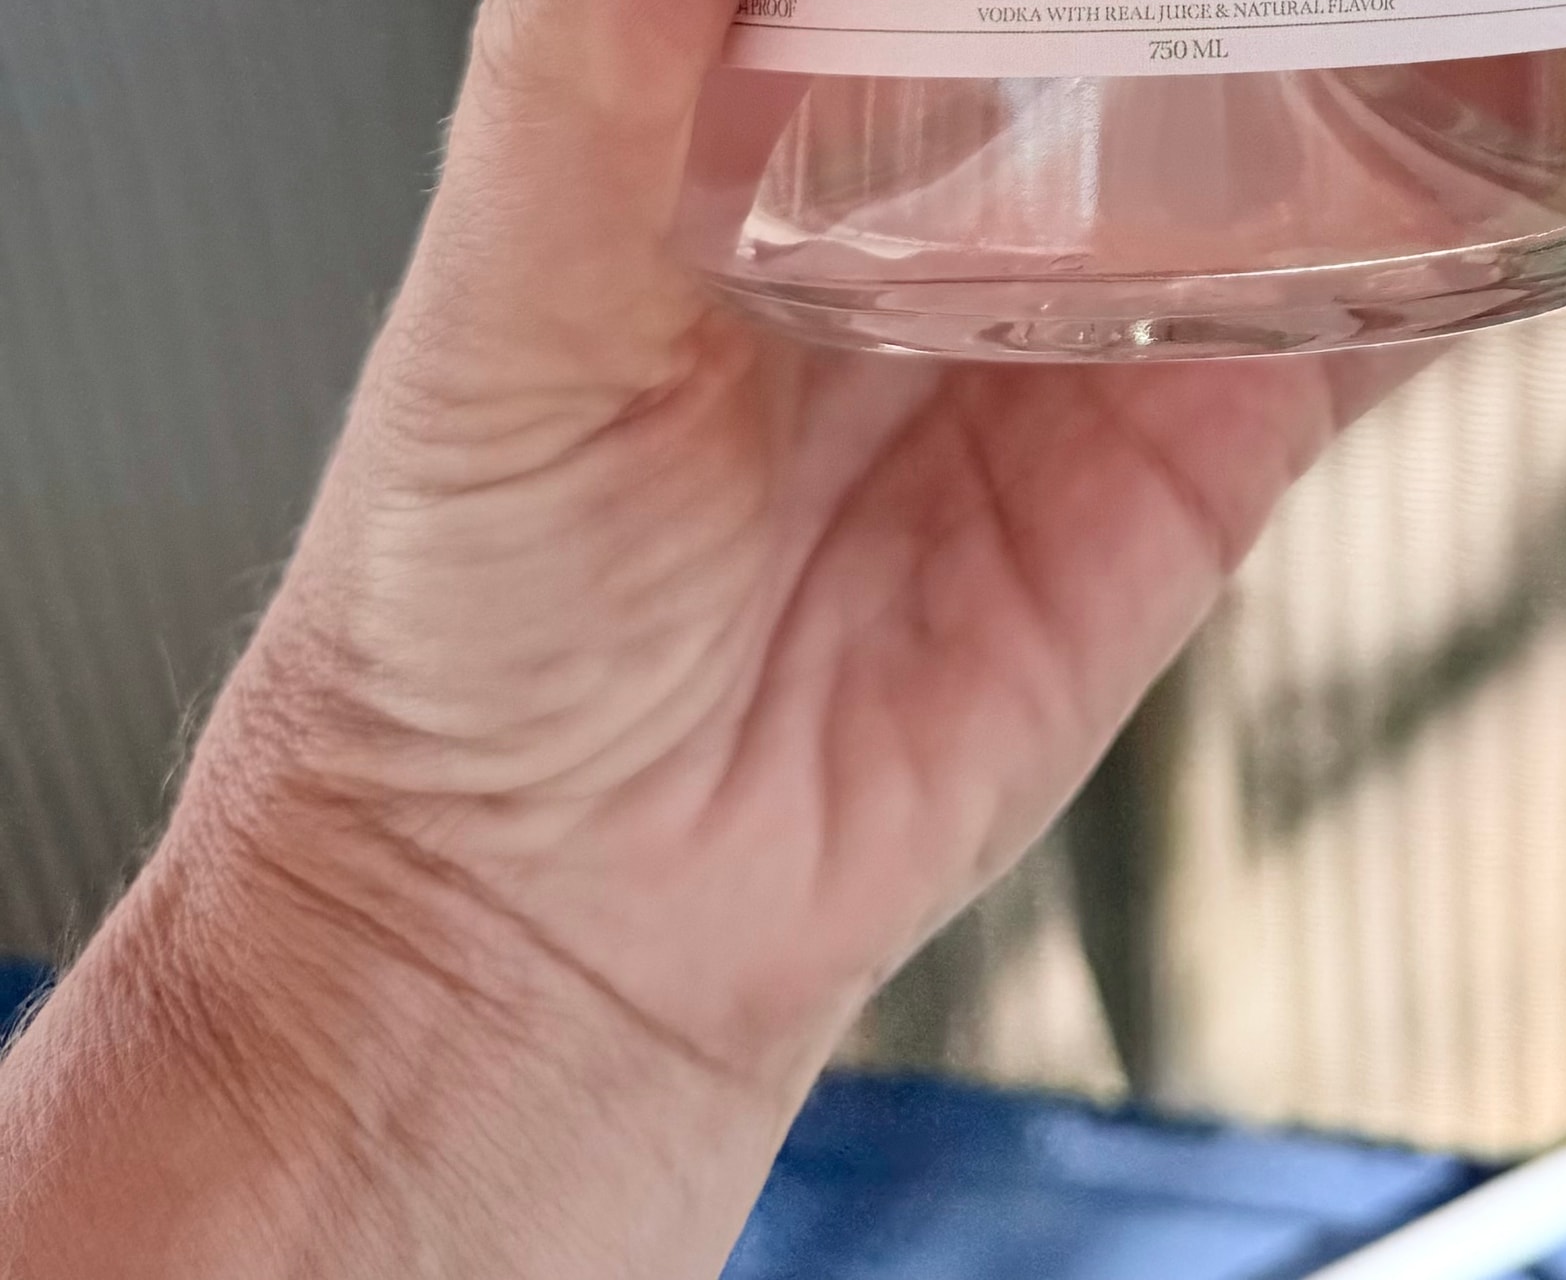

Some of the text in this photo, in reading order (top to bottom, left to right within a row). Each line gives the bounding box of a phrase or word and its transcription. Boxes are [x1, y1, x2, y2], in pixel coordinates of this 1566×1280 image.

[977, 6, 1042, 23] VODKA
[1047, 6, 1101, 22] WITH
[1105, 5, 1155, 22] REAL
[1157, 4, 1212, 24] JUICE
[1215, 3, 1229, 18] &
[1233, 0, 1324, 18] NATURAL
[1149, 38, 1229, 59] 750 ML
